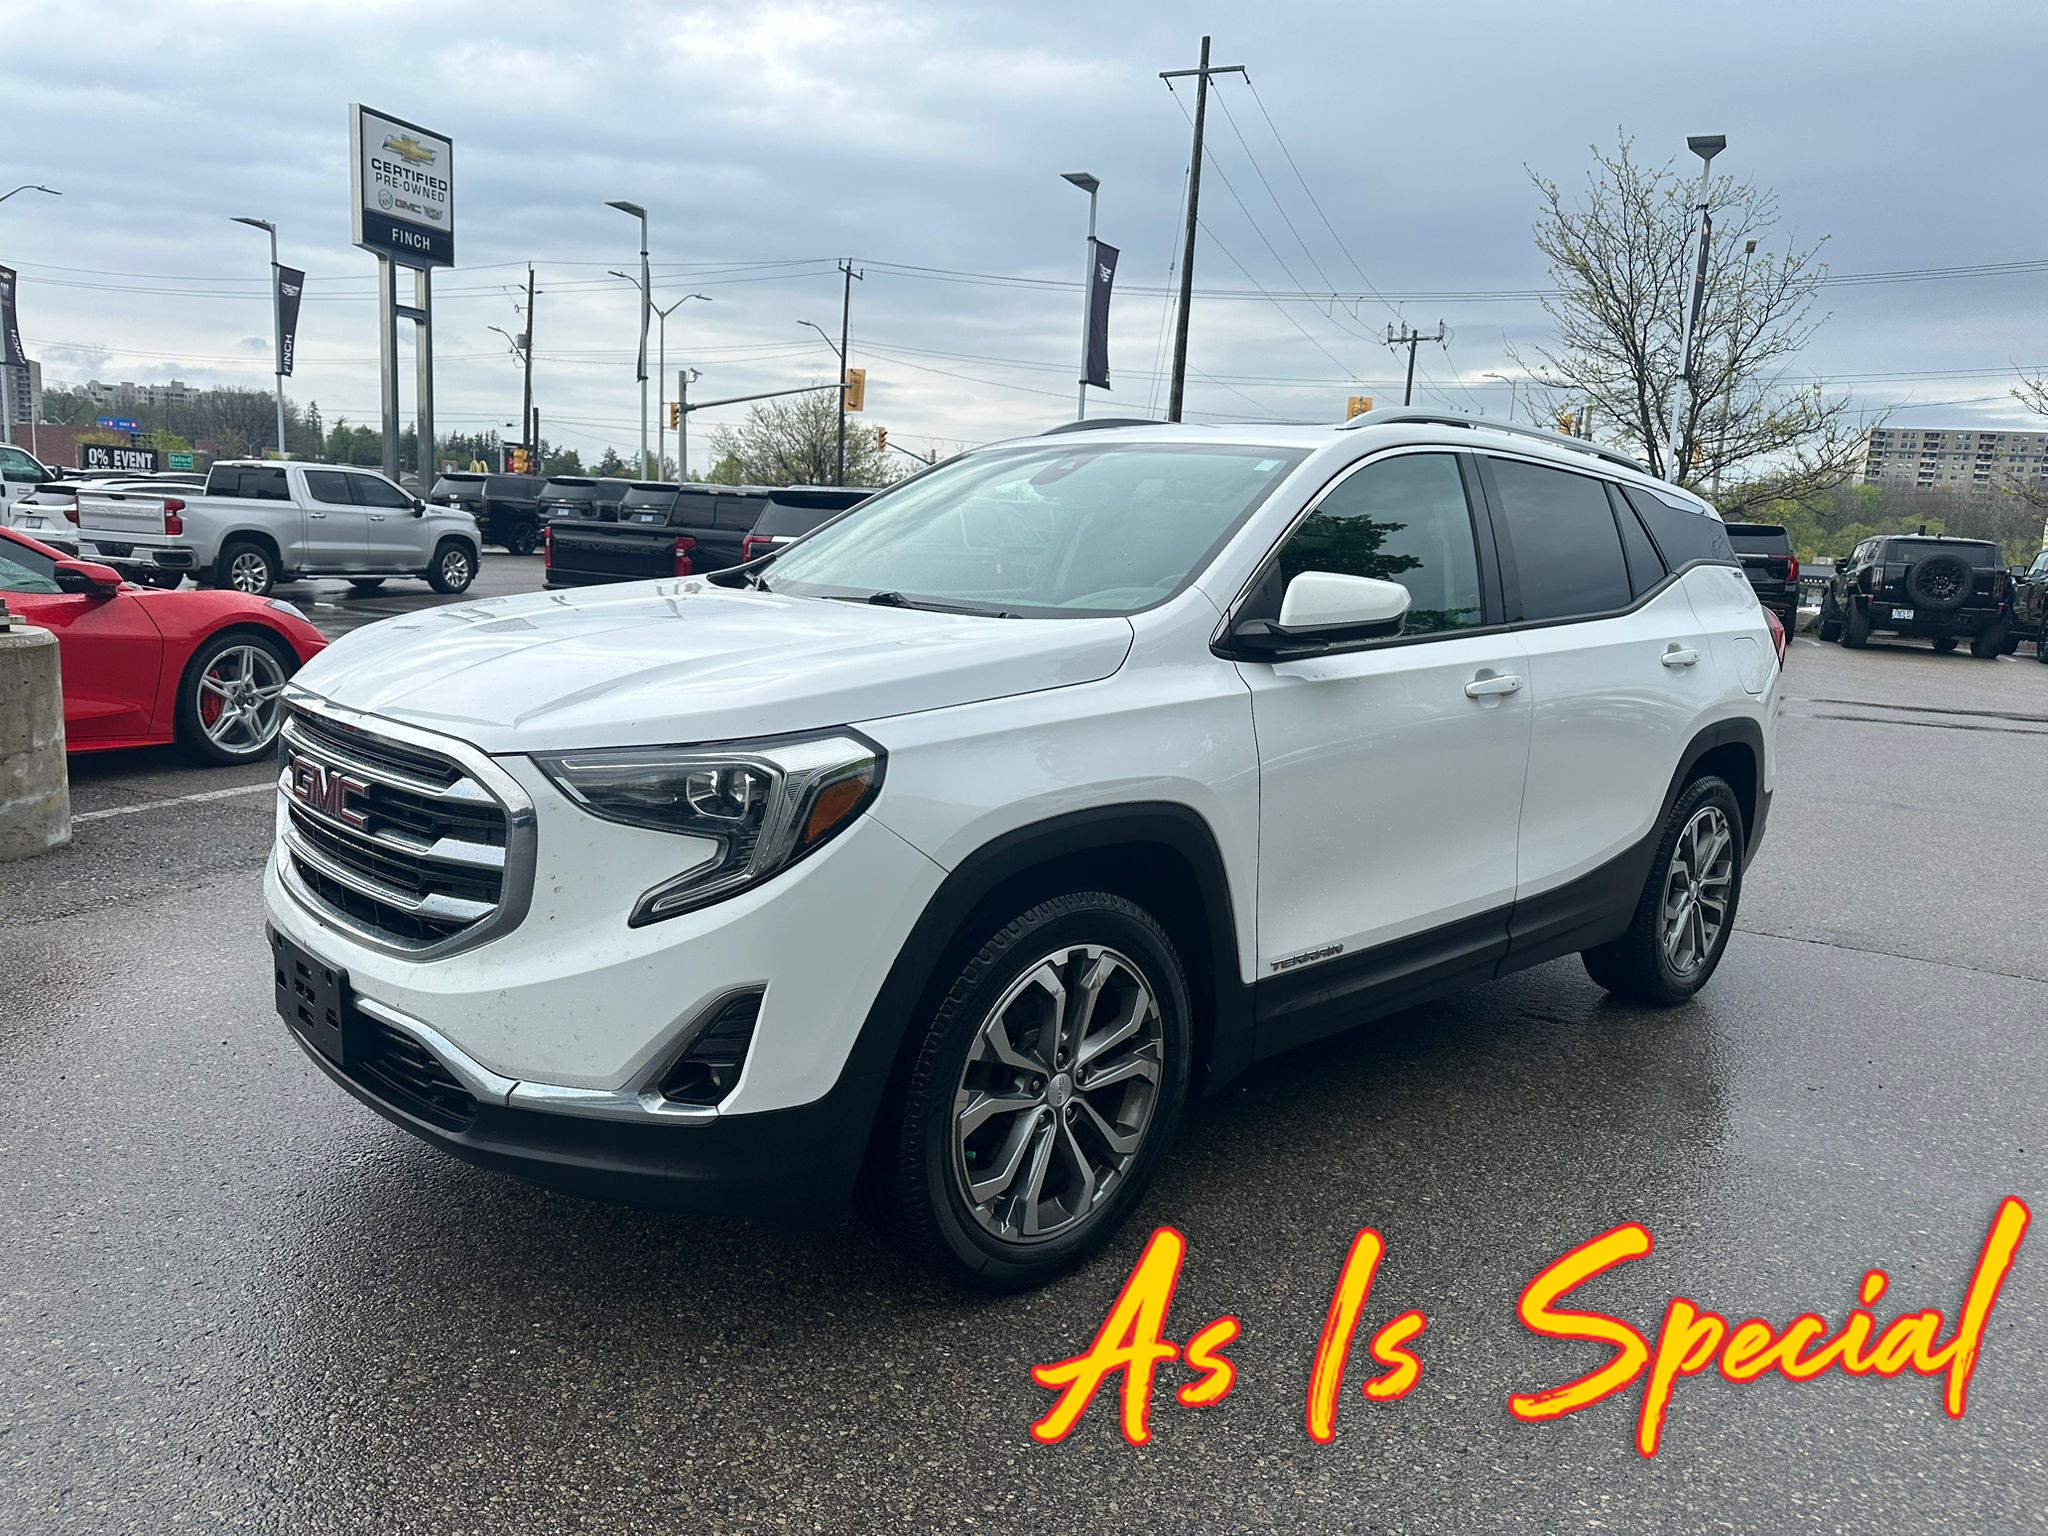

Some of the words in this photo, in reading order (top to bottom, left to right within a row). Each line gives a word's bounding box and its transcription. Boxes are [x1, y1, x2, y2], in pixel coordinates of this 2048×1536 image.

[371, 158, 448, 191] CERTIFIED
[375, 173, 445, 203] PRE-OWNED
[394, 199, 422, 214] GMC
[392, 228, 430, 250] FINCH
[10, 328, 26, 363] FINCH
[284, 334, 293, 373] FINCH
[88, 448, 109, 465] 0%
[113, 450, 153, 469] EVENT
[293, 755, 370, 831] GMC
[1270, 943, 1344, 972] TERRAIN
